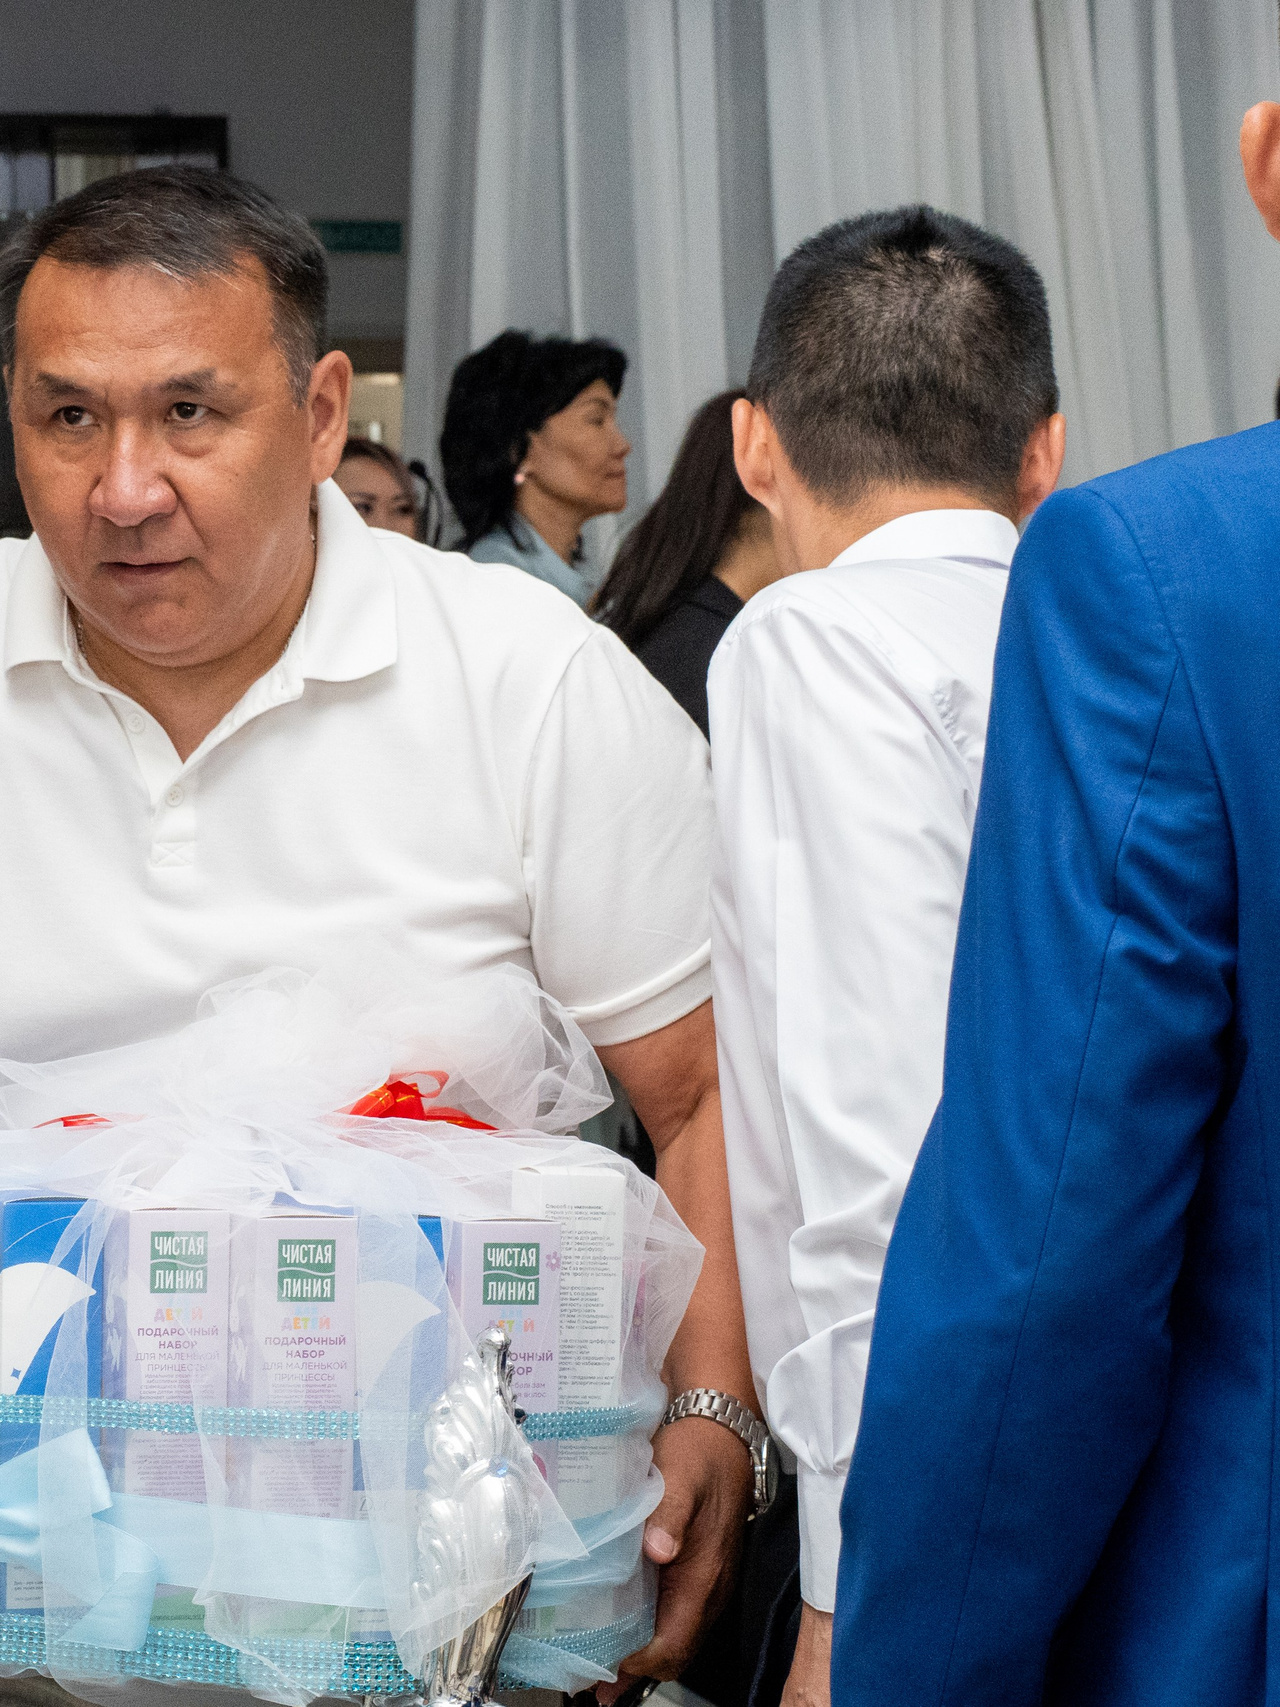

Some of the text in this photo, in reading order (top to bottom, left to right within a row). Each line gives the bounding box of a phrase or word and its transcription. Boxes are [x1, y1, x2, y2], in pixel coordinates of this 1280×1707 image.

[154, 1236, 204, 1256] ЧИСТАЯ
[282, 1244, 332, 1264] ЧИСТАЯ
[487, 1248, 537, 1267] ЧИСТАЯ
[154, 1270, 203, 1289] ЛИНИЯ
[282, 1278, 331, 1298] ЛИНИЯ
[487, 1282, 535, 1301] ЛИНИЯ
[137, 1325, 219, 1337] ПОДАРОЧНЫЙ
[158, 1340, 198, 1350] НАБОР
[265, 1335, 346, 1347] ПОДАРОЧНЫЙ
[135, 1352, 156, 1362] ДЛЯ
[285, 1350, 325, 1358] НАБОР
[509, 1350, 554, 1361] ОЧНЫЙ
[262, 1360, 347, 1371] ДЛЯ МАЛЕНЬКОЙ
[274, 1373, 335, 1382] ПРИНЦЕССЫ
